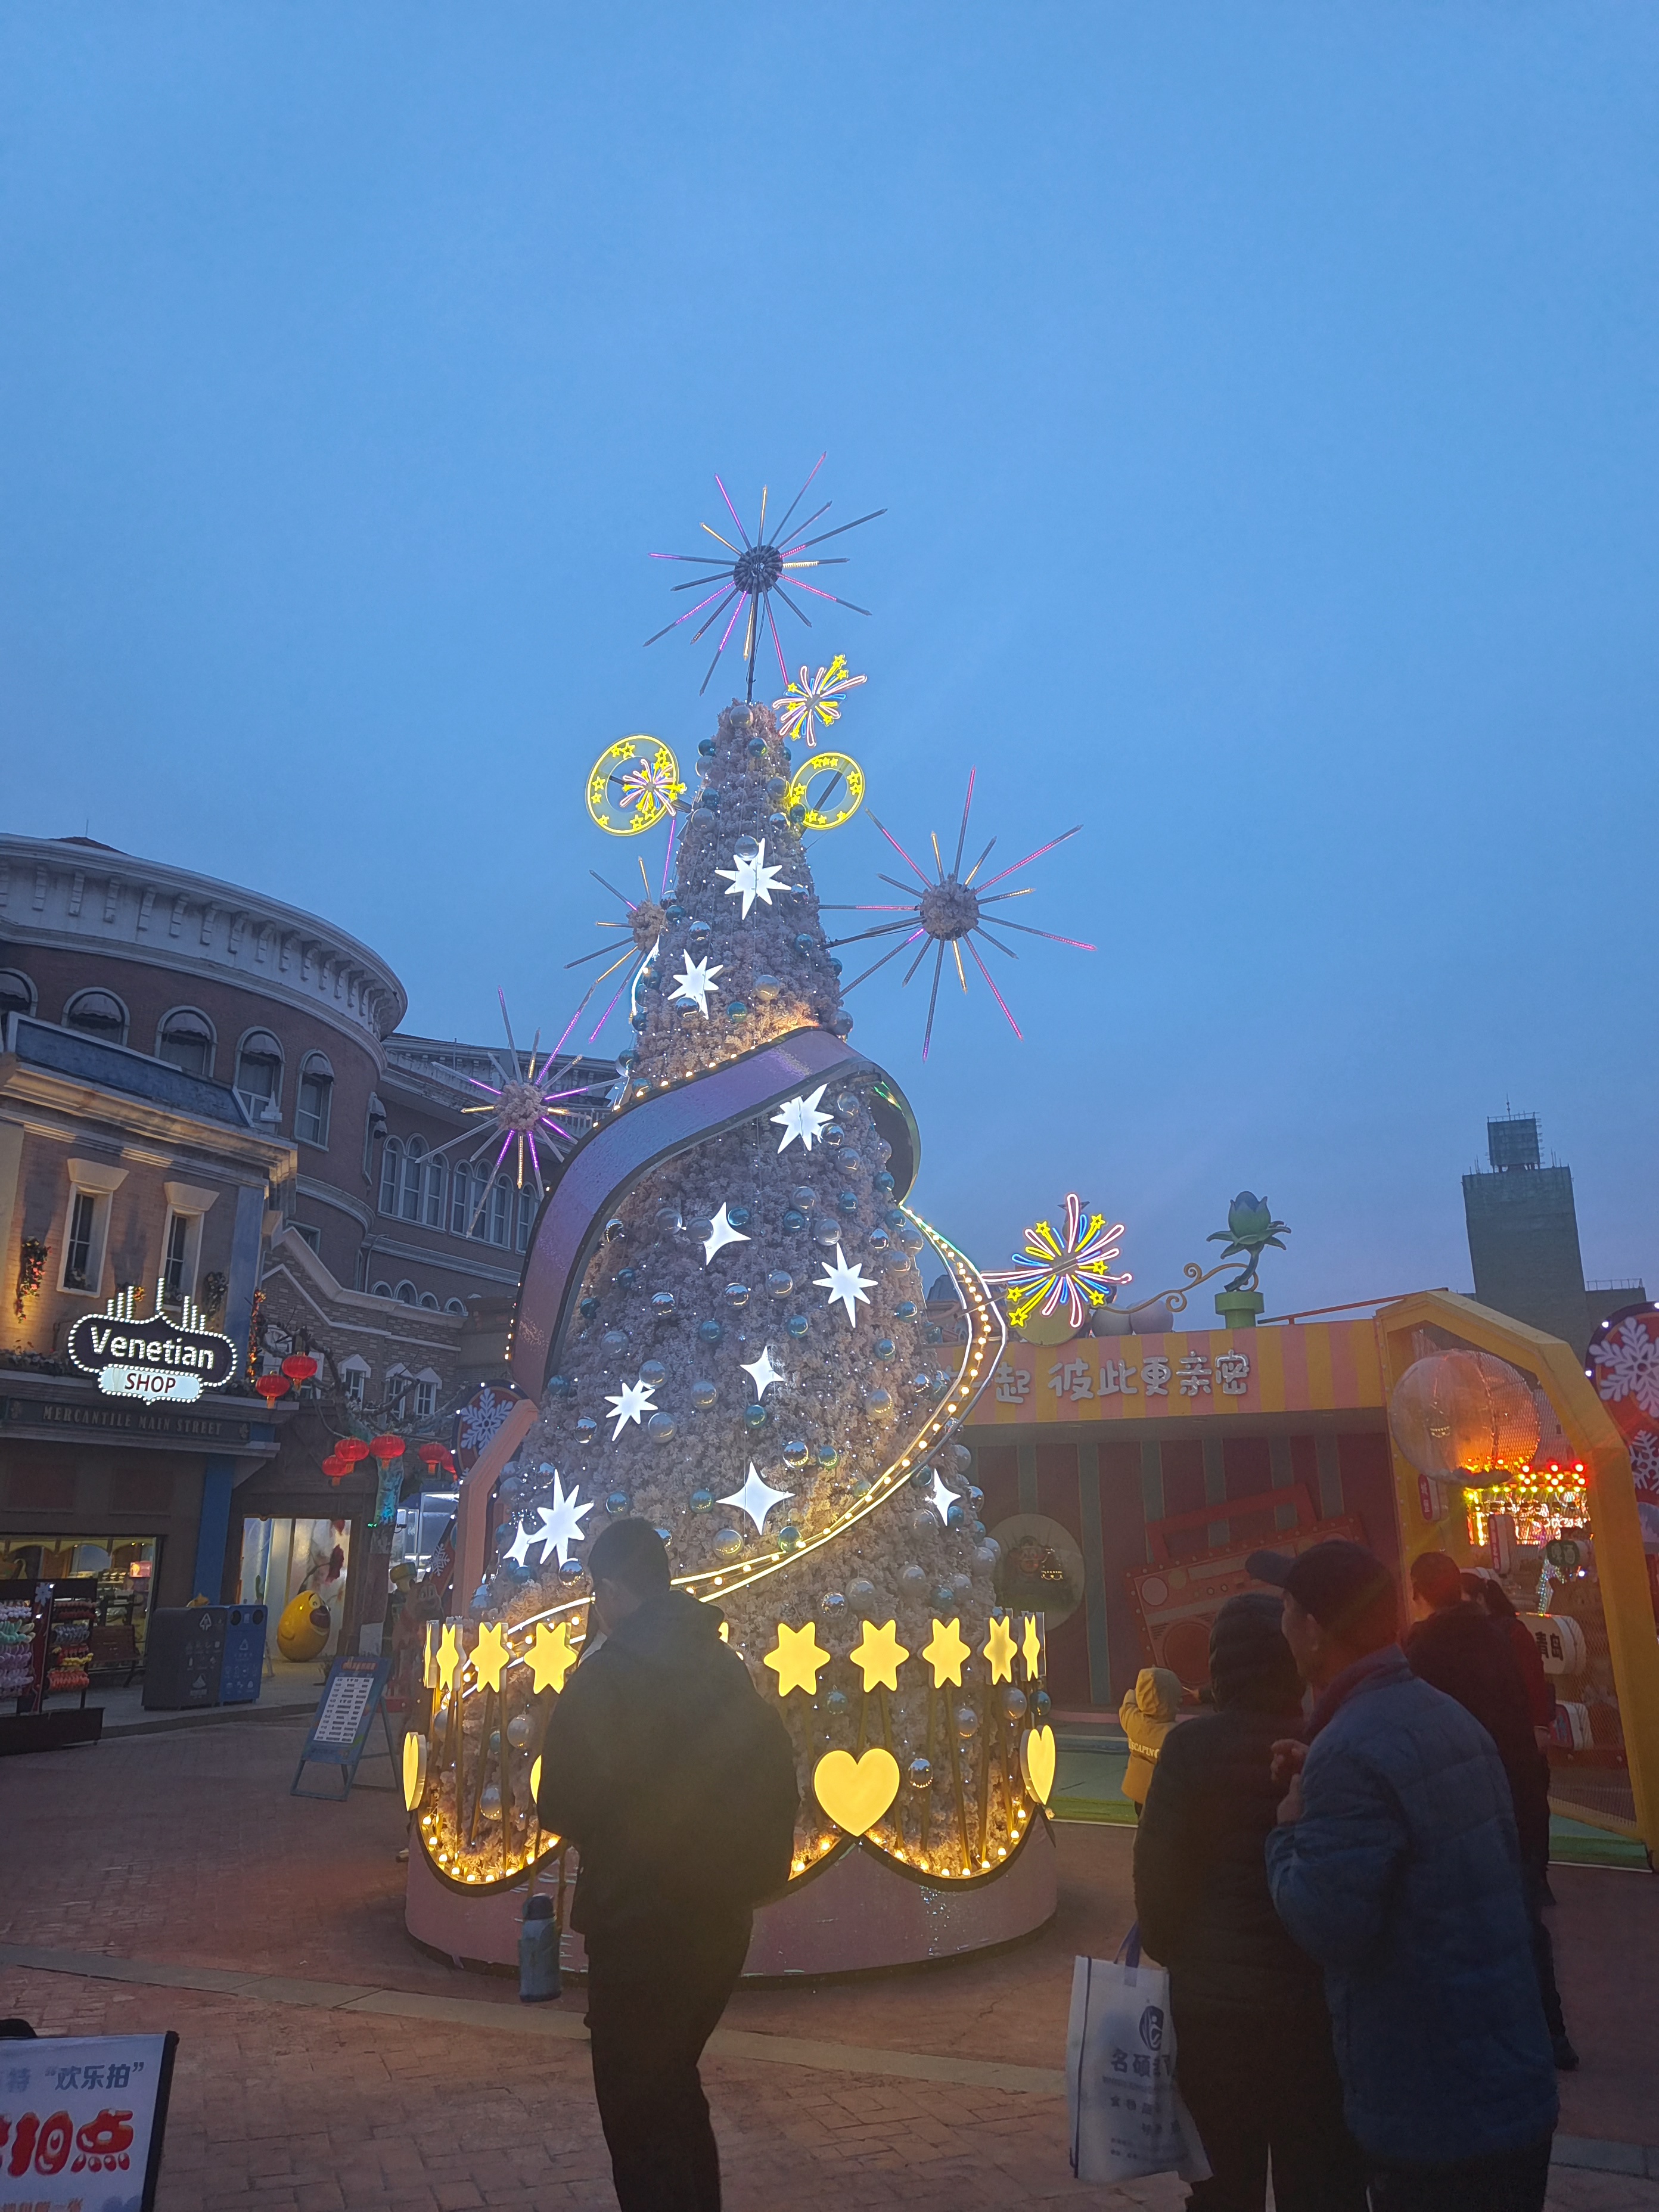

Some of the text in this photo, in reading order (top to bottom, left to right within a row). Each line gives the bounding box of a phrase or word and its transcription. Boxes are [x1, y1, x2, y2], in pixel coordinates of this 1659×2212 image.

[91, 1324, 214, 1369] Venetian
[125, 1372, 176, 1393] SHOP
[1048, 1349, 1250, 1402] 彼此更亲密
[43, 1406, 222, 1436] MERCANTILE MAIN STREET
